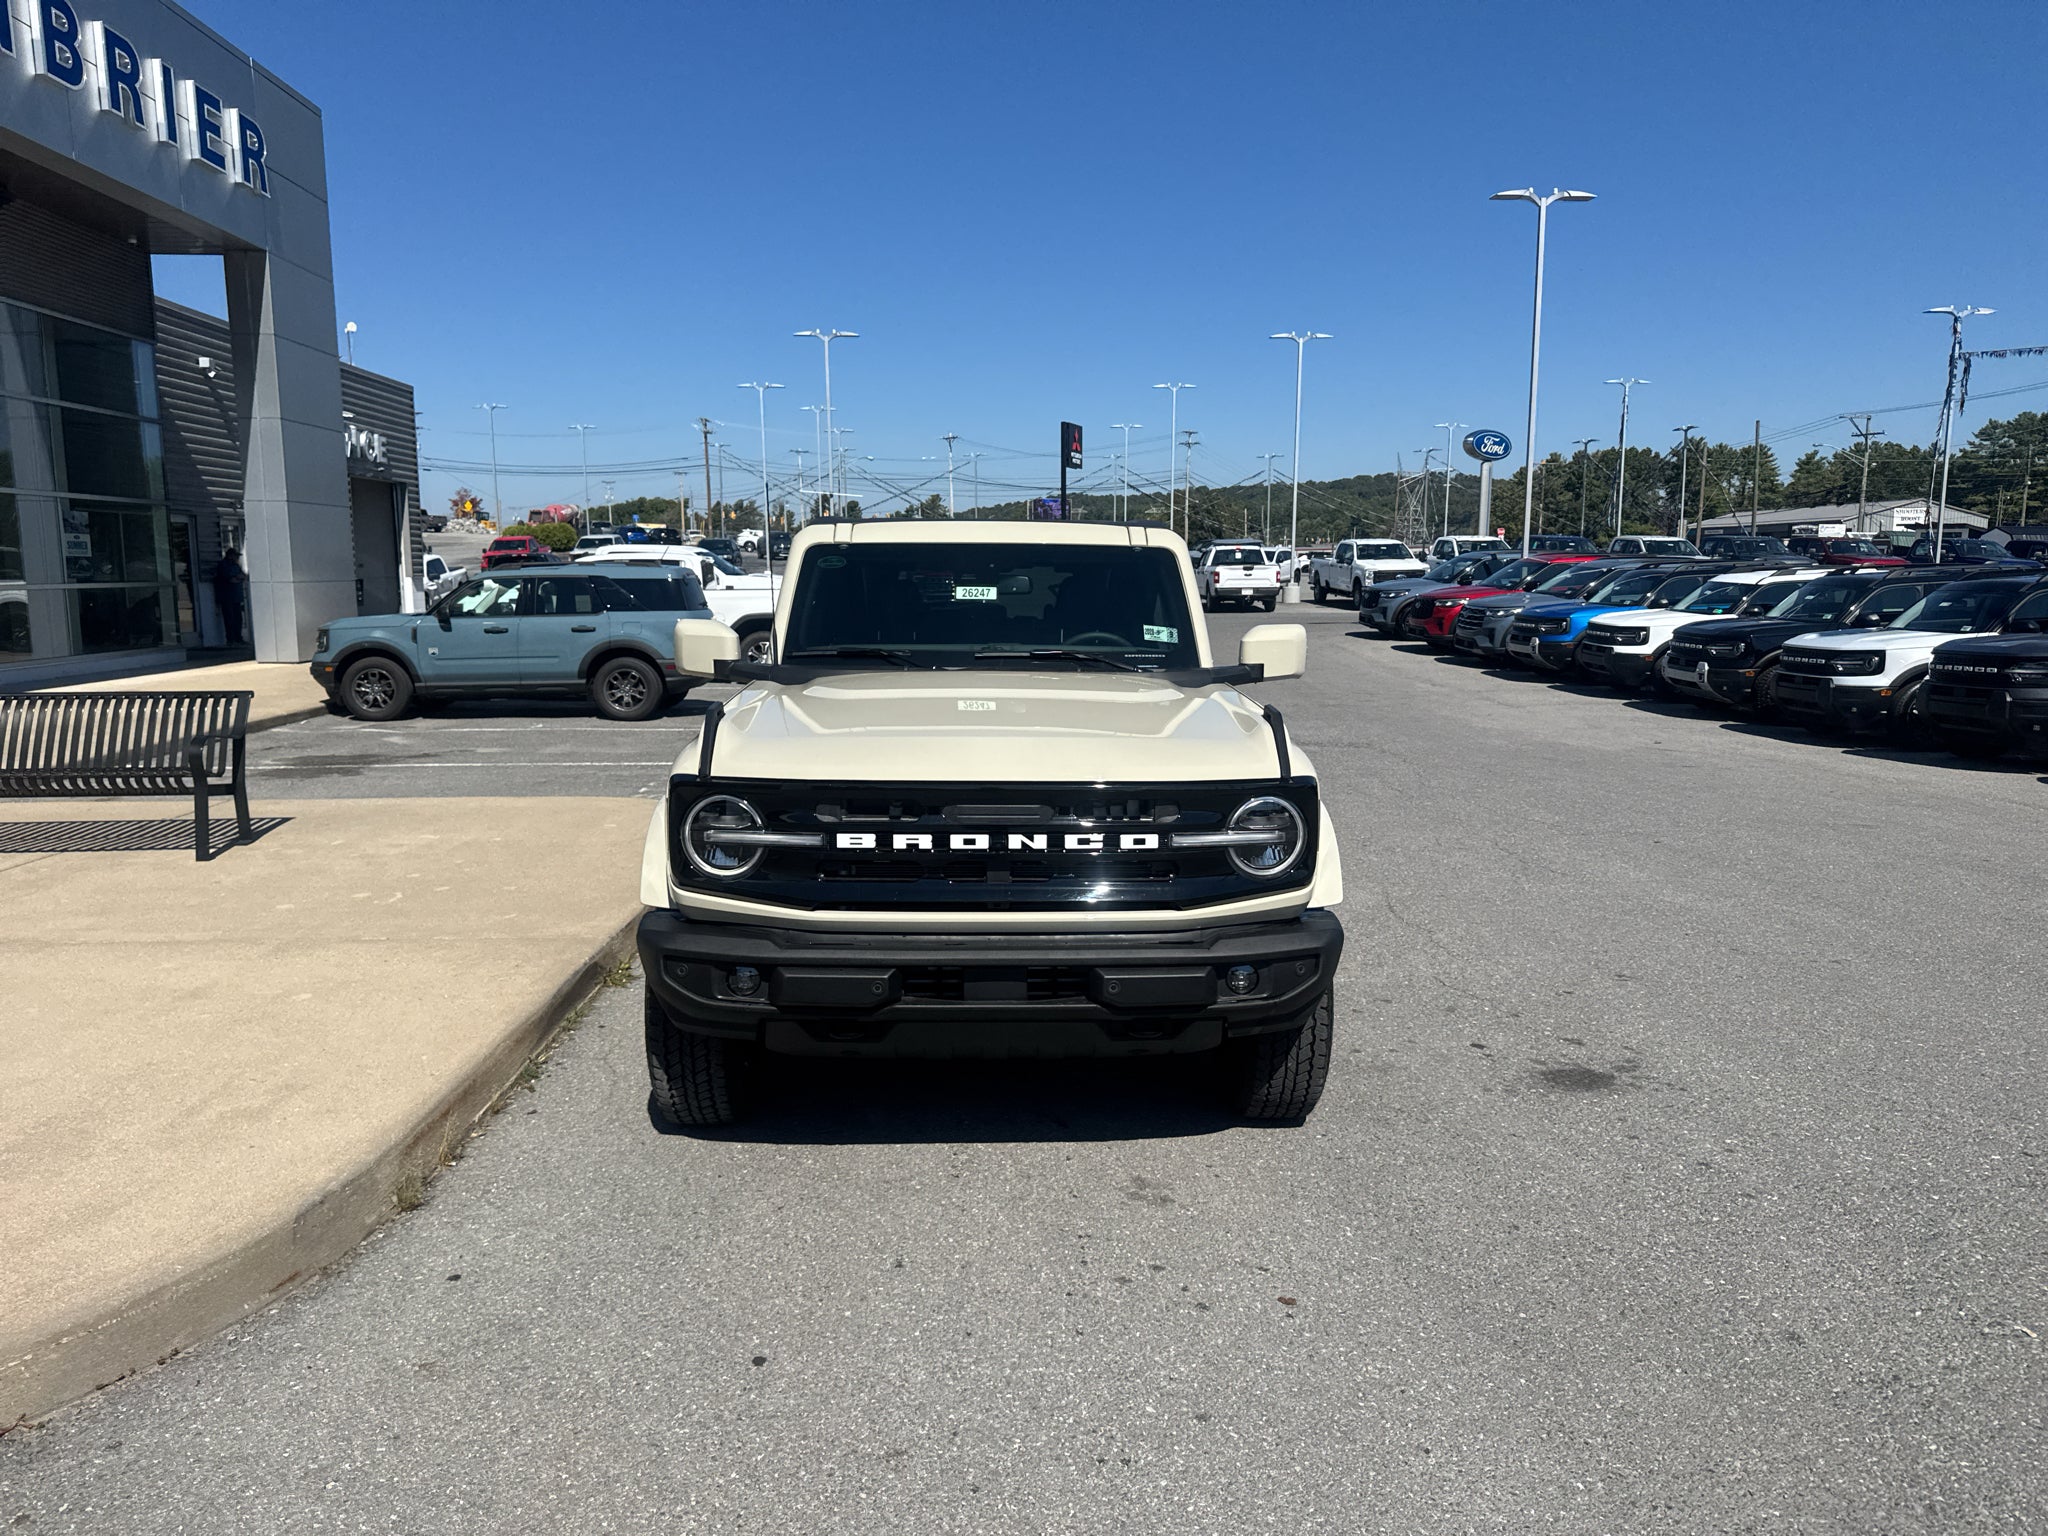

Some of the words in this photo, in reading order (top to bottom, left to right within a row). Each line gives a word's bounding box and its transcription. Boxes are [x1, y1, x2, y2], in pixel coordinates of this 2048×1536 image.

[1481, 436, 1505, 455] Ford
[962, 588, 991, 598] 26247
[1783, 655, 1825, 664] BRONCO
[1935, 664, 1998, 673] BRONCO
[836, 833, 1159, 849] BRONCO
